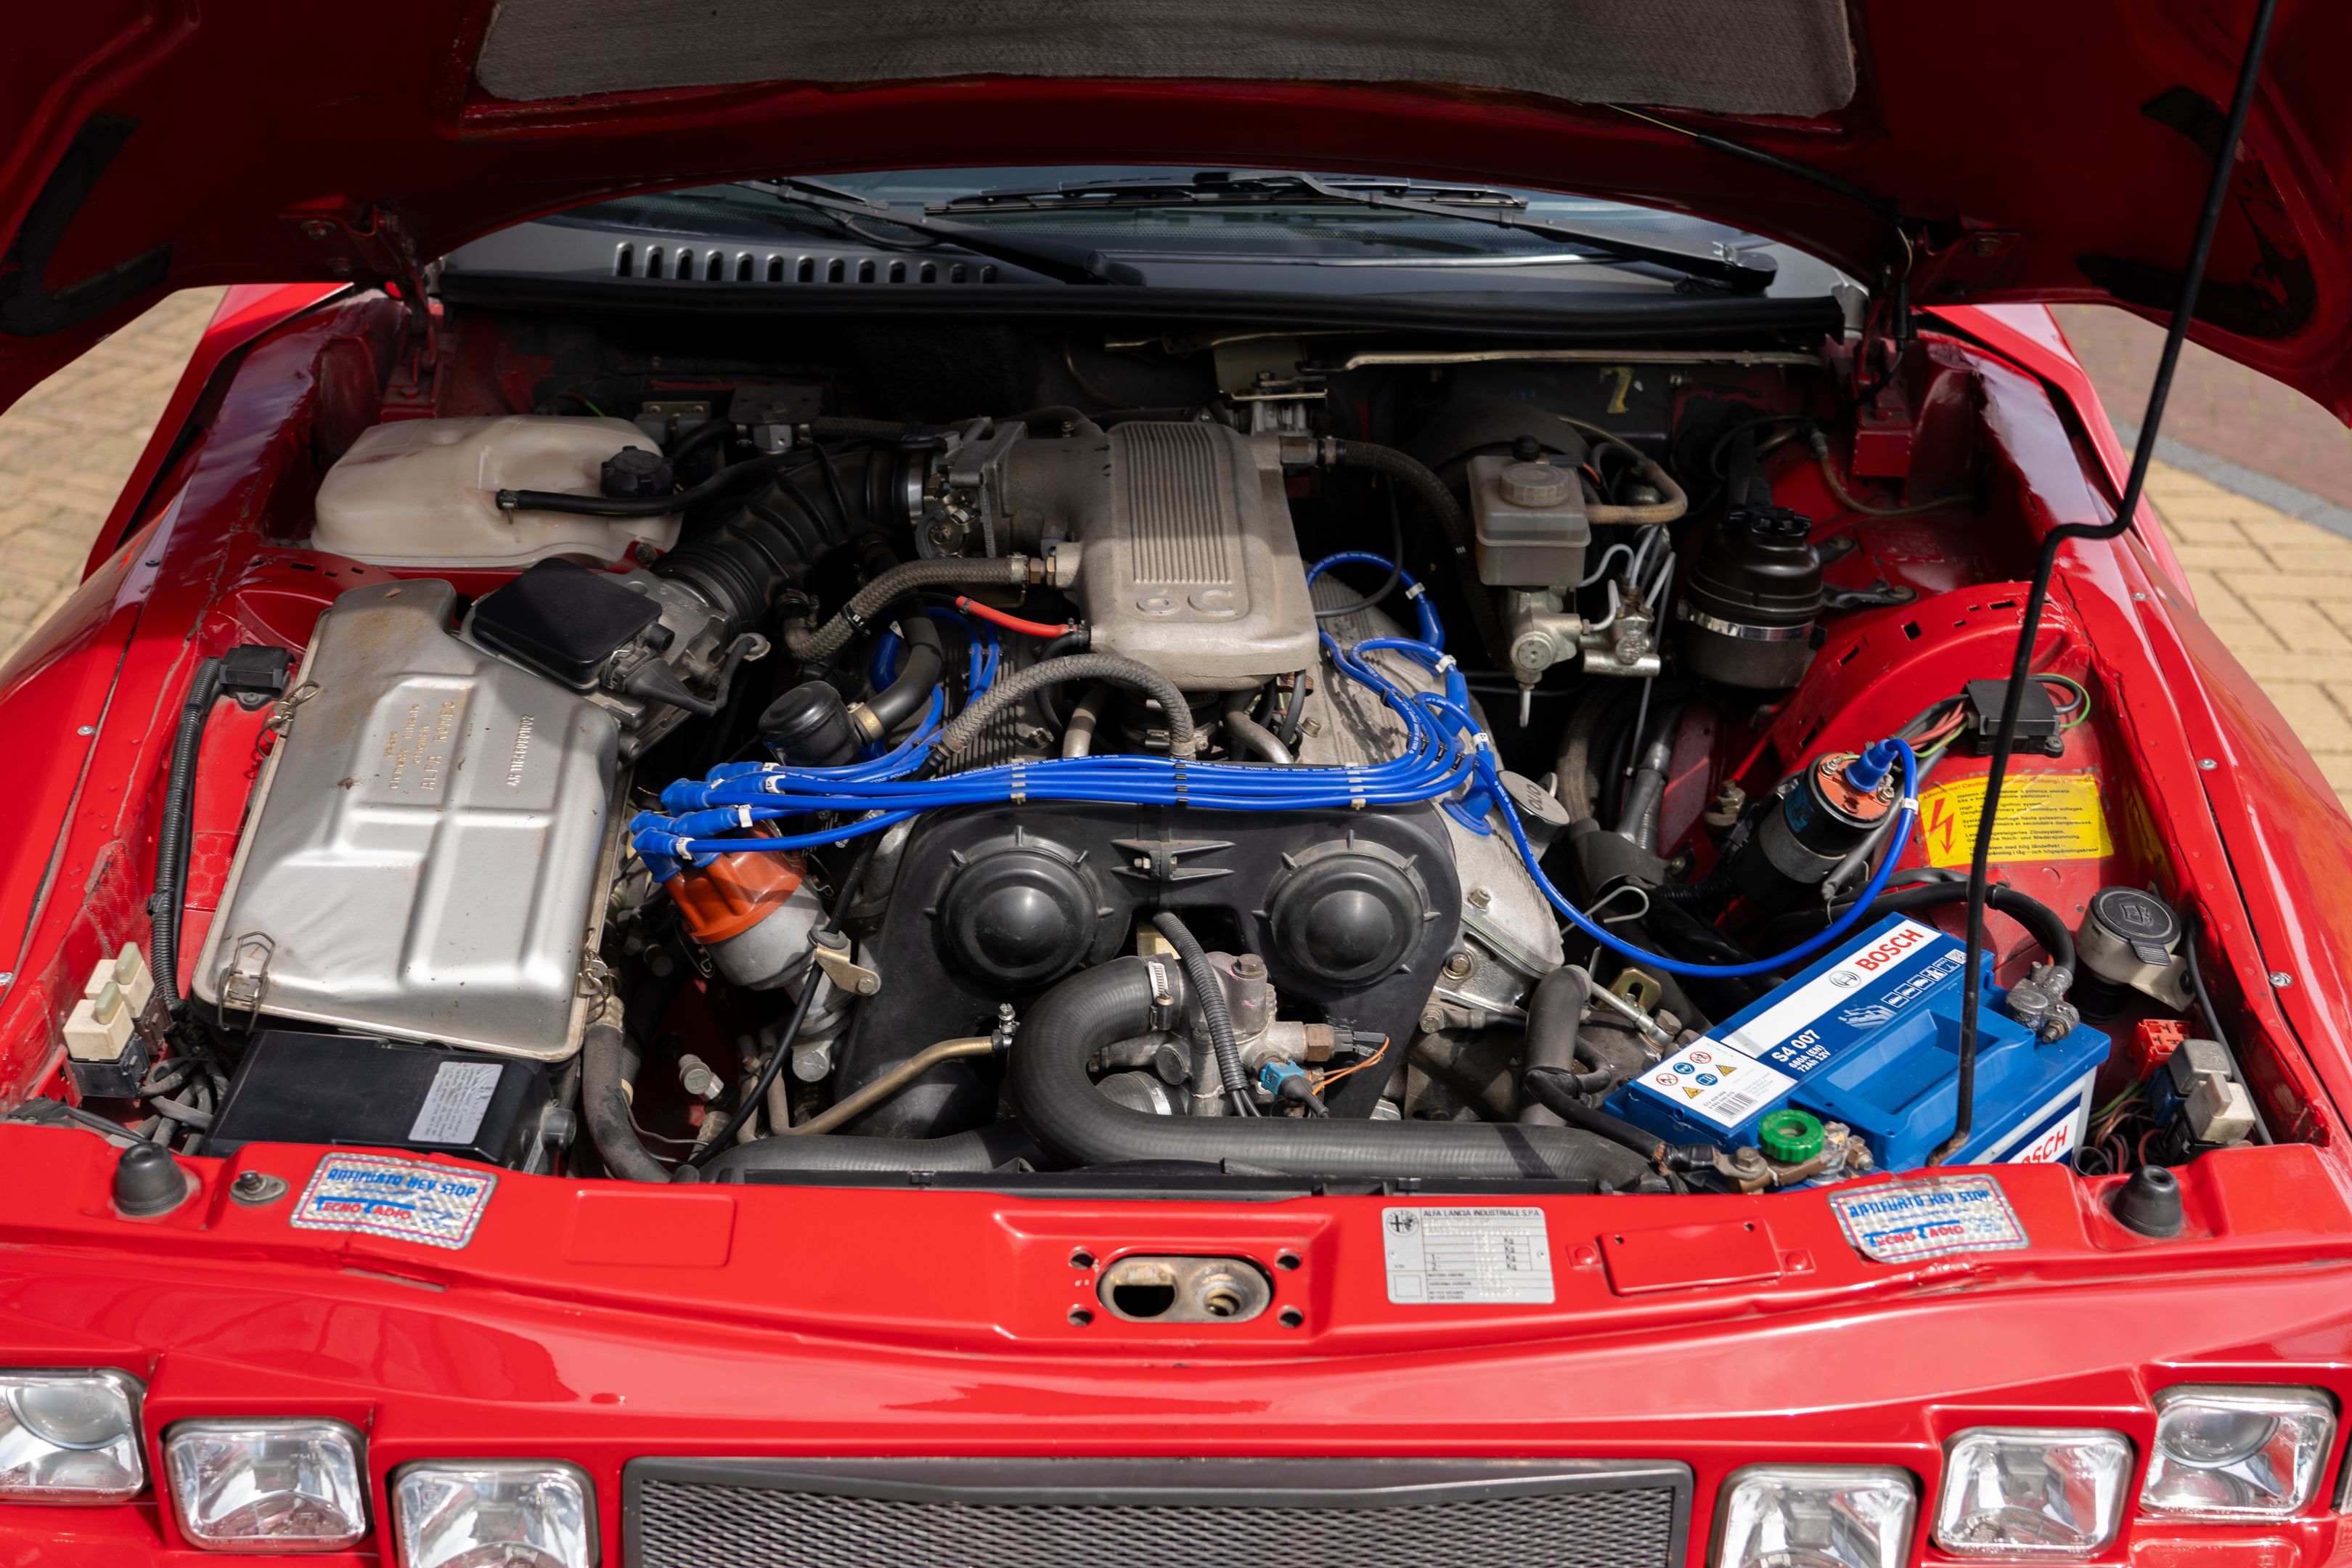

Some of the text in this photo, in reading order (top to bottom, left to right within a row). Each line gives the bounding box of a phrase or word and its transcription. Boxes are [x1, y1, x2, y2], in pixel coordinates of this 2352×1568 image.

[1136, 586, 1237, 617] 6C
[420, 701, 455, 791] ALFA ROMEO
[506, 773, 522, 786] AR
[1527, 784, 1544, 812] OLIO
[1855, 929, 1924, 971] BOSCH
[1771, 1029, 1821, 1062] S4 007
[1788, 1045, 1826, 1069] 680A (EN)
[1797, 1050, 1831, 1073] 72Ah 12V
[439, 1183, 477, 1198] STOP
[1848, 1190, 1990, 1217] ANTIFURTO KEY STOP
[1506, 1262, 1517, 1271] Kg
